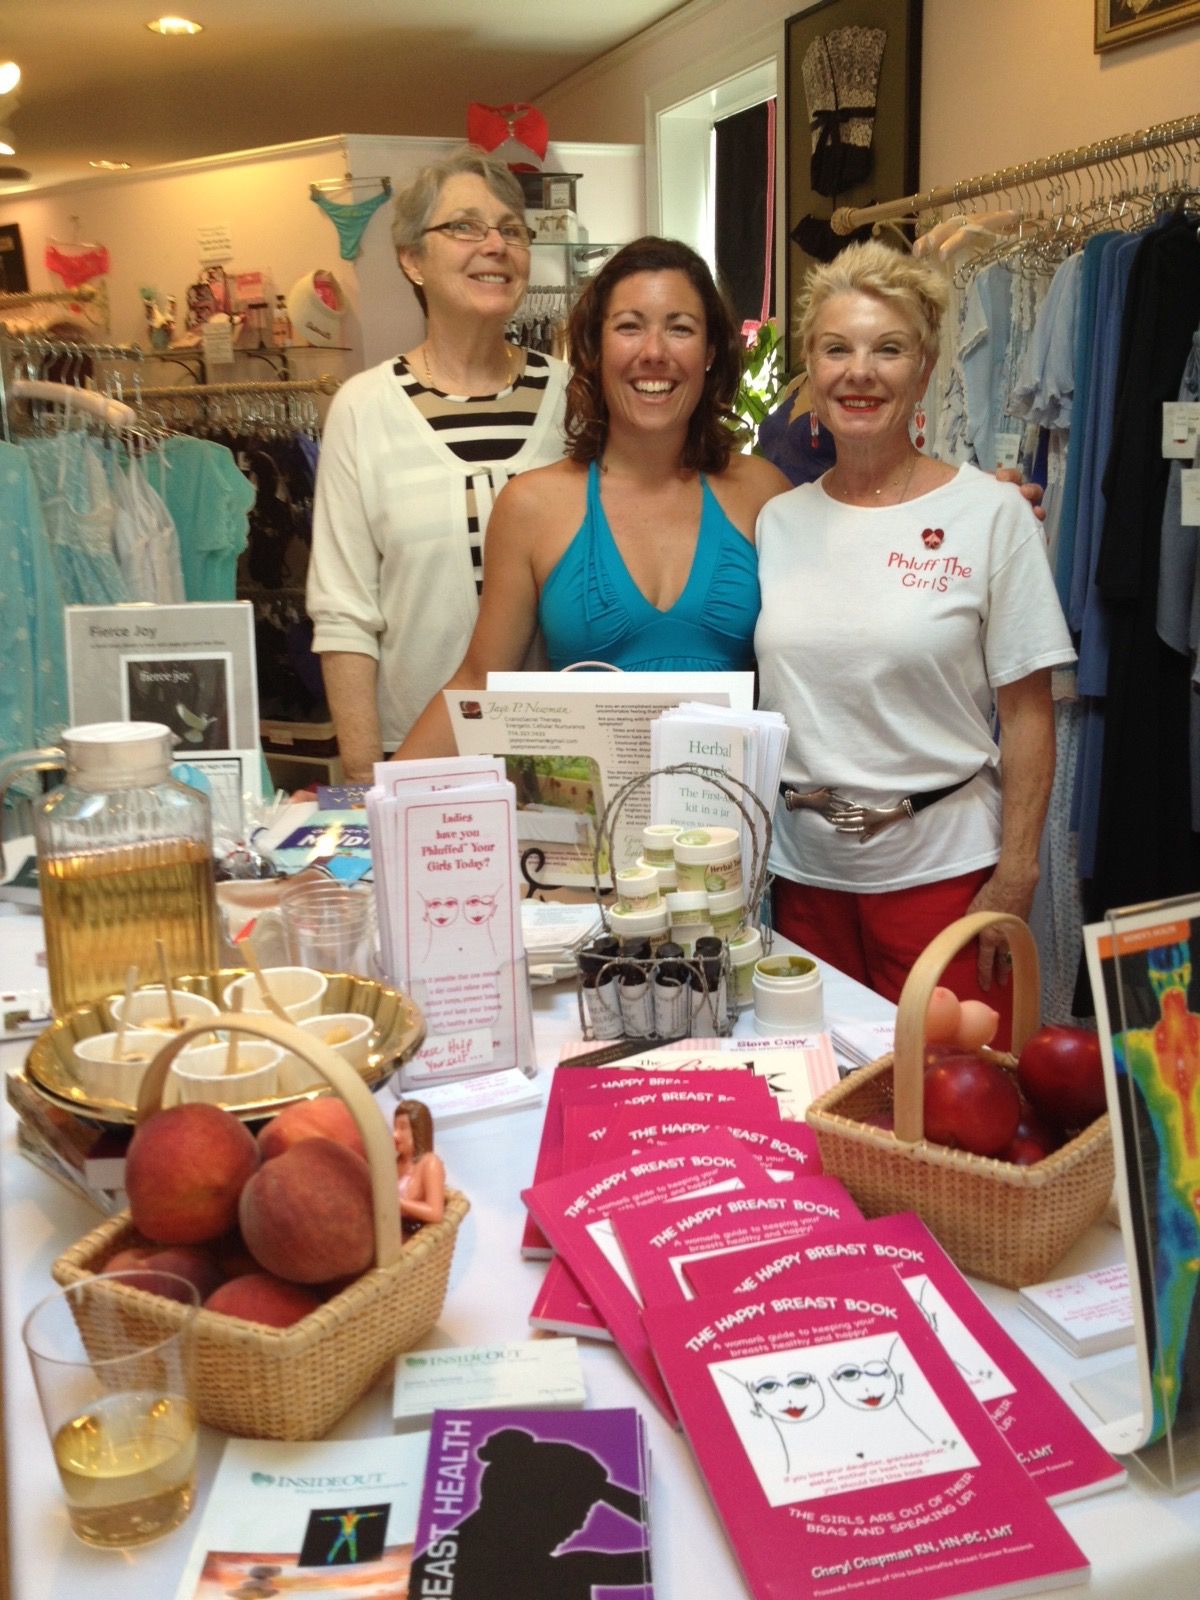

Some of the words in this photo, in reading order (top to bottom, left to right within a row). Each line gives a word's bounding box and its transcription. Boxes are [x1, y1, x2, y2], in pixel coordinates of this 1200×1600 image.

[888, 552, 940, 572] Phluff
[942, 556, 972, 578] The
[89, 625, 129, 638] Fierce
[135, 625, 158, 639] Joy
[689, 740, 732, 758] Herbal
[680, 787, 699, 798] The
[686, 802, 698, 813] kit
[701, 804, 710, 814] in
[442, 813, 473, 824] Ladies
[436, 829, 457, 840] have
[459, 829, 480, 841] you
[471, 842, 496, 853] Your
[455, 857, 490, 871] Today?
[774, 1038, 808, 1046] Copy
[661, 1091, 714, 1102] BREAST
[628, 1126, 658, 1141] THE
[661, 1123, 710, 1135] HAPPY
[770, 1139, 808, 1164] BOOK
[564, 1195, 590, 1218] THE
[586, 1170, 627, 1199] HAPPY
[630, 1156, 686, 1177] BREAST
[691, 1155, 737, 1169] BOOK
[650, 1225, 678, 1249] THE
[677, 1205, 722, 1232] HAPPY
[727, 1199, 787, 1213] BREAST
[793, 1199, 840, 1219] BOOK
[723, 1228, 748, 1239] guide
[763, 1219, 798, 1231] keeping
[800, 1216, 820, 1226] your
[689, 1241, 724, 1253] breasts
[727, 1235, 761, 1247] healthy
[764, 1231, 782, 1239] and
[755, 1252, 801, 1282] HAPPY
[805, 1244, 867, 1261] BREAST
[873, 1244, 925, 1263] BOOK
[685, 1326, 716, 1353] THE
[714, 1302, 766, 1333] HAPPY
[770, 1296, 837, 1312] BREAST
[844, 1298, 898, 1320] BOOK
[712, 1342, 722, 1351] A
[768, 1330, 795, 1342] guide
[799, 1327, 810, 1336] to
[812, 1319, 853, 1334] keeping
[854, 1317, 876, 1329] your
[730, 1344, 769, 1358] breasts
[772, 1338, 811, 1351] healthy
[814, 1333, 833, 1343] and
[835, 1327, 869, 1340] happy!
[1029, 1444, 1054, 1460] LMT
[433, 1420, 472, 1515] HEALTH
[793, 1474, 806, 1483] you
[808, 1470, 824, 1478] love
[826, 1467, 843, 1477] your
[837, 1471, 867, 1481] mother
[824, 1486, 838, 1495] you
[840, 1479, 868, 1490] should
[870, 1477, 883, 1487] buy
[789, 1507, 815, 1521] THE
[820, 1514, 864, 1525] GIRLS
[869, 1512, 896, 1523] ARE
[899, 1503, 925, 1518] OUT
[928, 1495, 943, 1508] OF
[943, 1472, 975, 1497] THEIR
[806, 1523, 847, 1537] BRAS
[853, 1526, 885, 1537] AND
[890, 1505, 956, 1534] SPEAKING
[956, 1490, 977, 1506] UP!
[811, 1560, 852, 1579] Cheryl
[853, 1547, 914, 1571] Chapman
[914, 1541, 939, 1556] RN,
[940, 1530, 987, 1550] HN-BC,
[987, 1524, 1014, 1541] LMT
[421, 1523, 460, 1600] EAST
[848, 1580, 865, 1590] from
[882, 1574, 891, 1582] of
